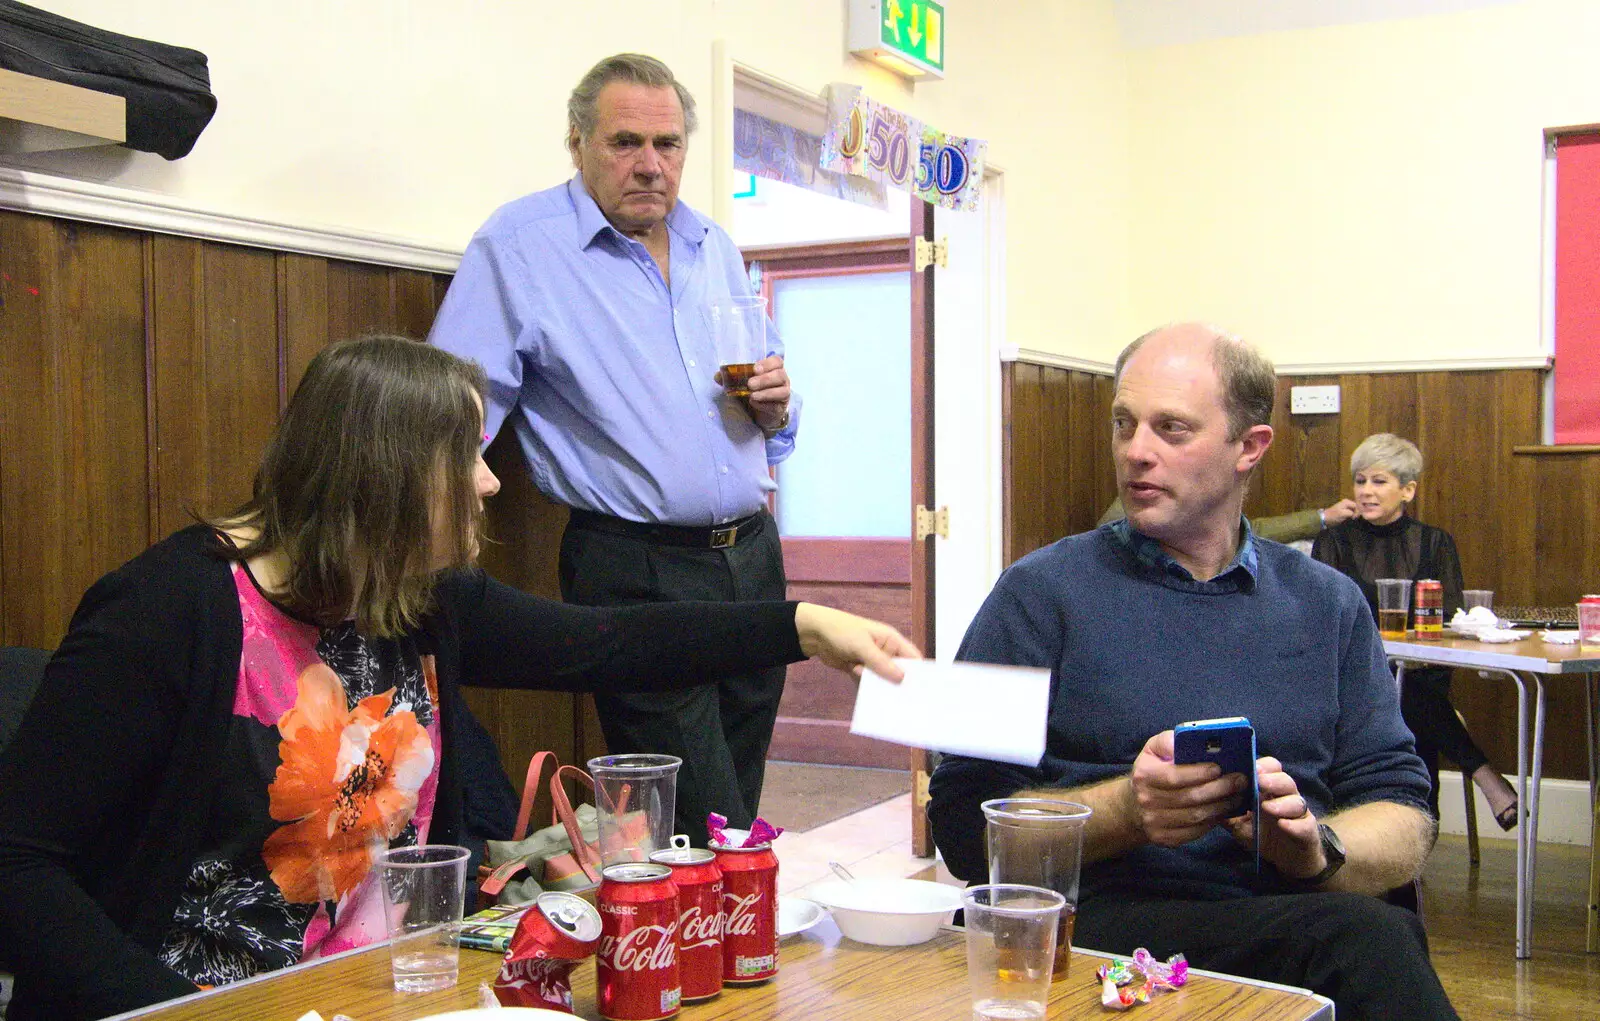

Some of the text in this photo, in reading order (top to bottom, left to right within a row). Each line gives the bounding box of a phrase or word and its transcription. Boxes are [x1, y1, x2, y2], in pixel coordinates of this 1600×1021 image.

[869, 110, 909, 185] 50
[919, 144, 969, 195] 50
[601, 904, 638, 915] CLASSIC
